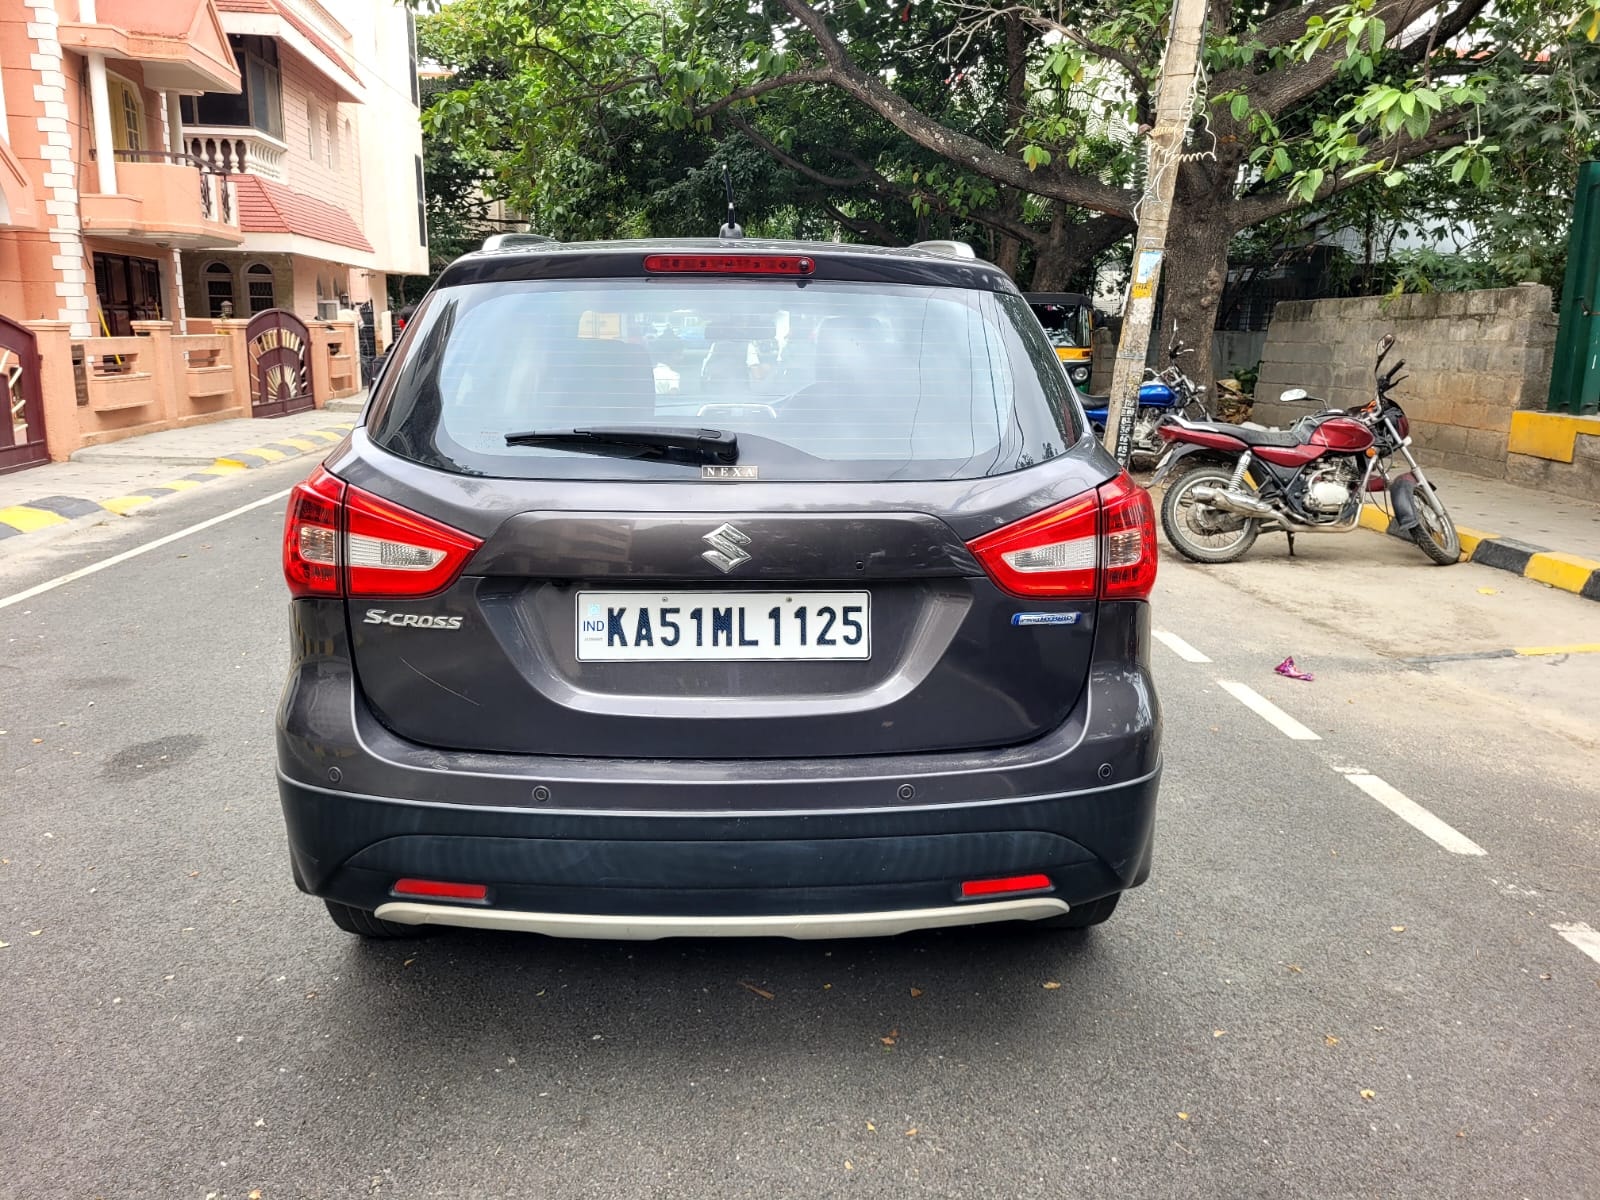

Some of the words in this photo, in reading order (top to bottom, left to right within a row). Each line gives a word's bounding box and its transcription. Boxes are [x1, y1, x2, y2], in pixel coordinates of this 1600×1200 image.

[706, 467, 755, 477] NEXA
[583, 620, 605, 632] IND
[607, 606, 863, 647] KA51ML1125
